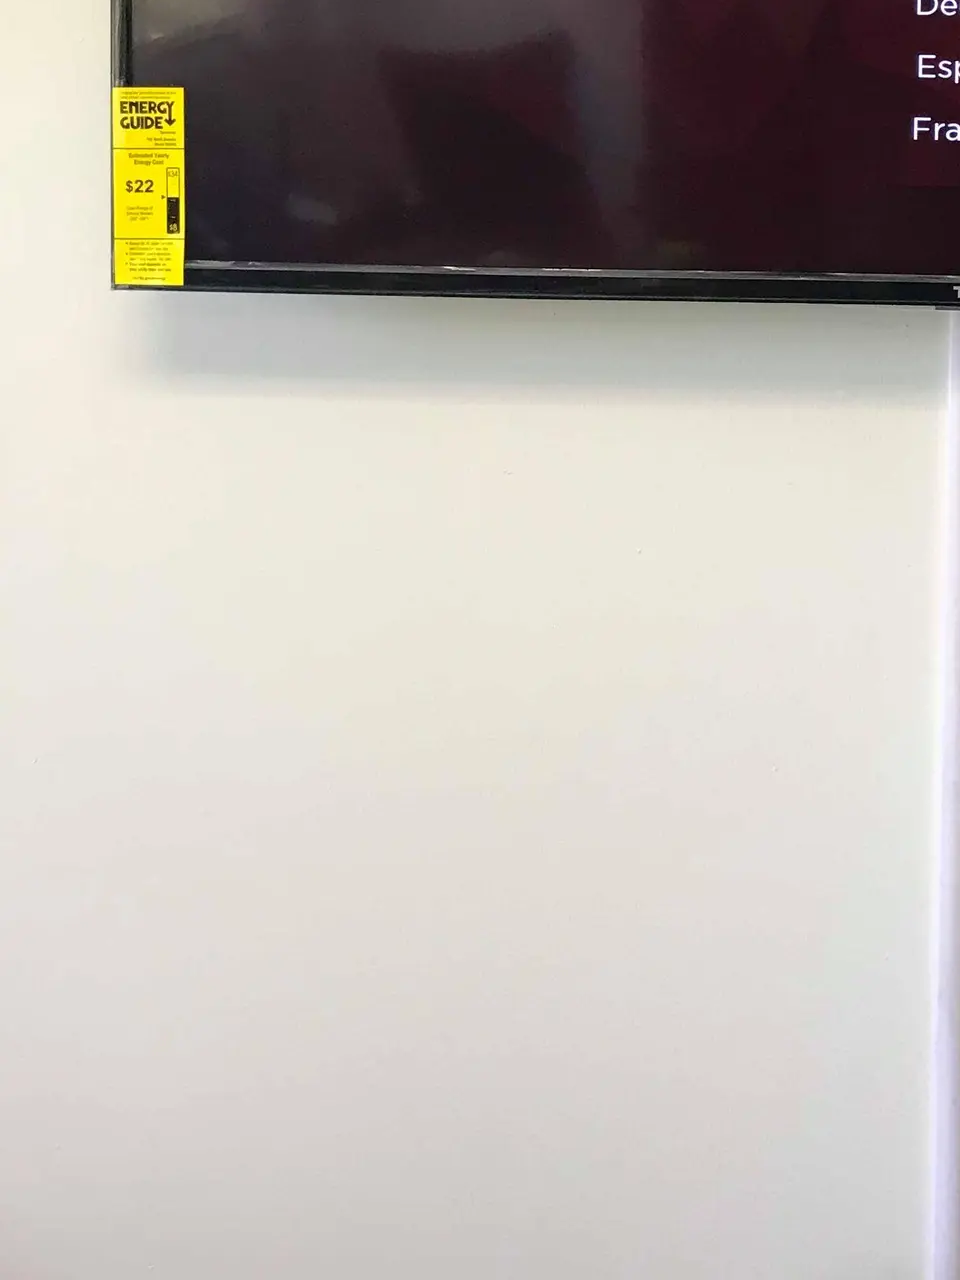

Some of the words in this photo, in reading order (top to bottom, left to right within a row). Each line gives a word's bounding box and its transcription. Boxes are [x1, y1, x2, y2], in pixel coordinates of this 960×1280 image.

[119, 101, 175, 115] ENERGY
[119, 116, 164, 130] GUIDE
[125, 179, 154, 193] $22
